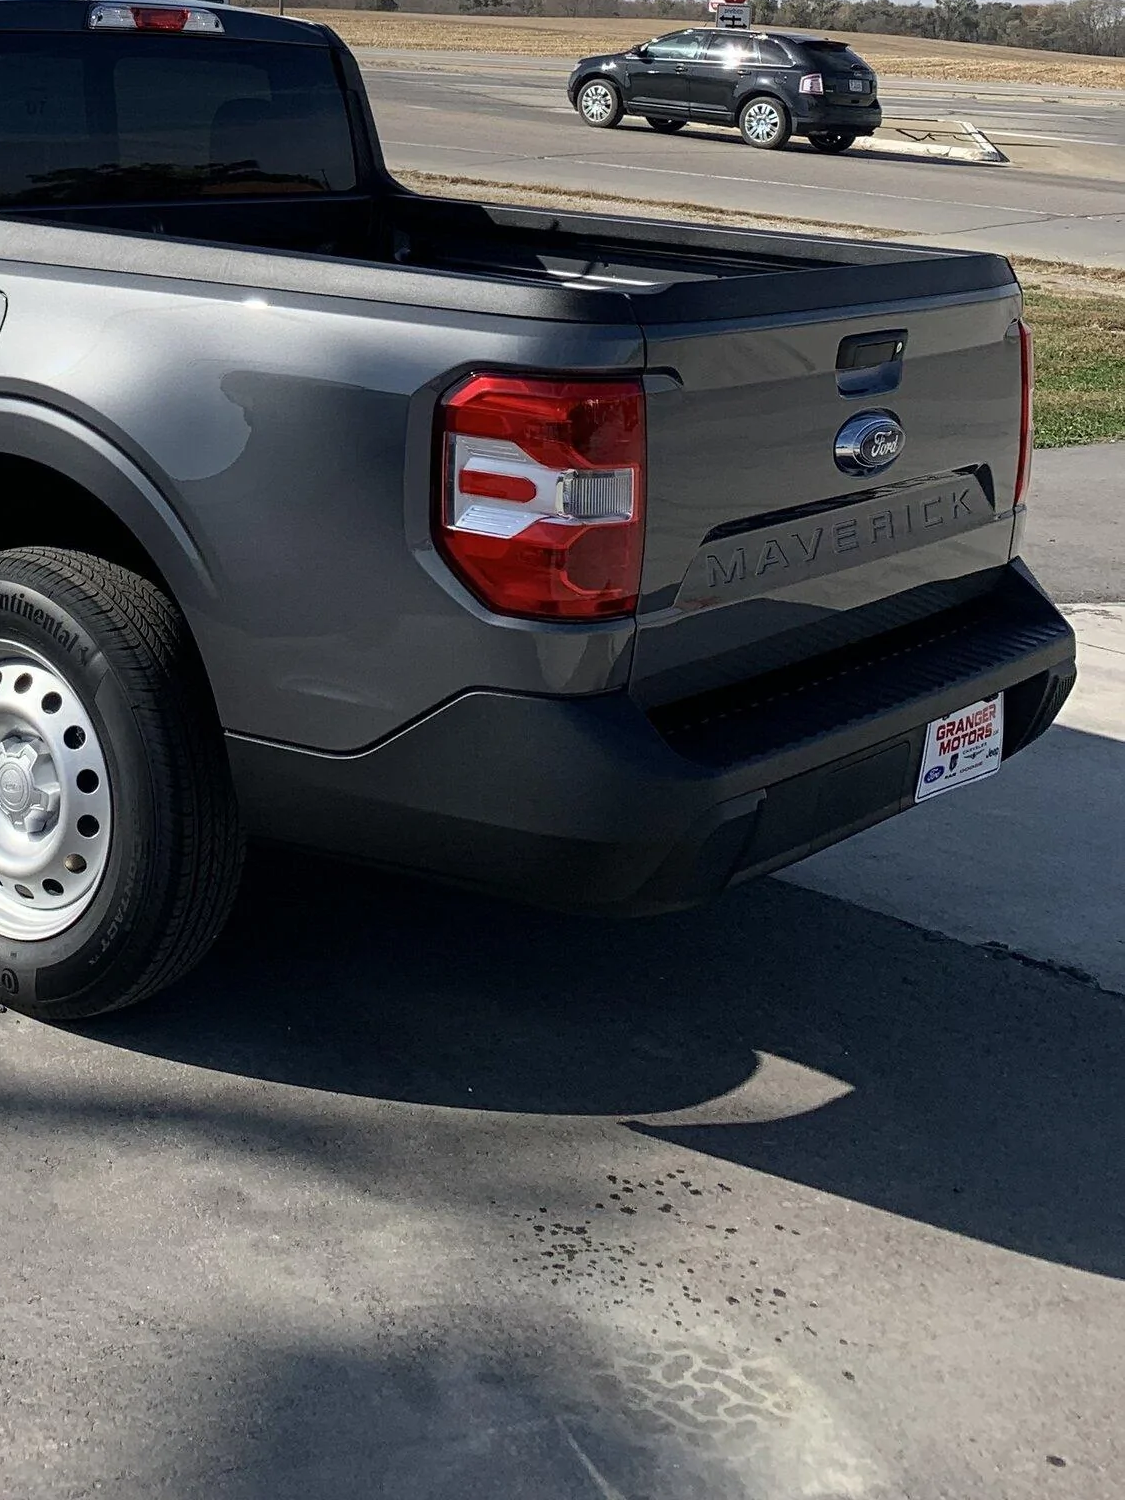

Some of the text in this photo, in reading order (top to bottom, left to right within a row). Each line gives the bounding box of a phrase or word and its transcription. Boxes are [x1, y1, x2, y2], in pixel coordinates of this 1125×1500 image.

[871, 430, 899, 457] Ford
[706, 488, 972, 587] MAVERICK
[936, 703, 996, 741] GRANGER
[939, 722, 993, 756] MOTORS
